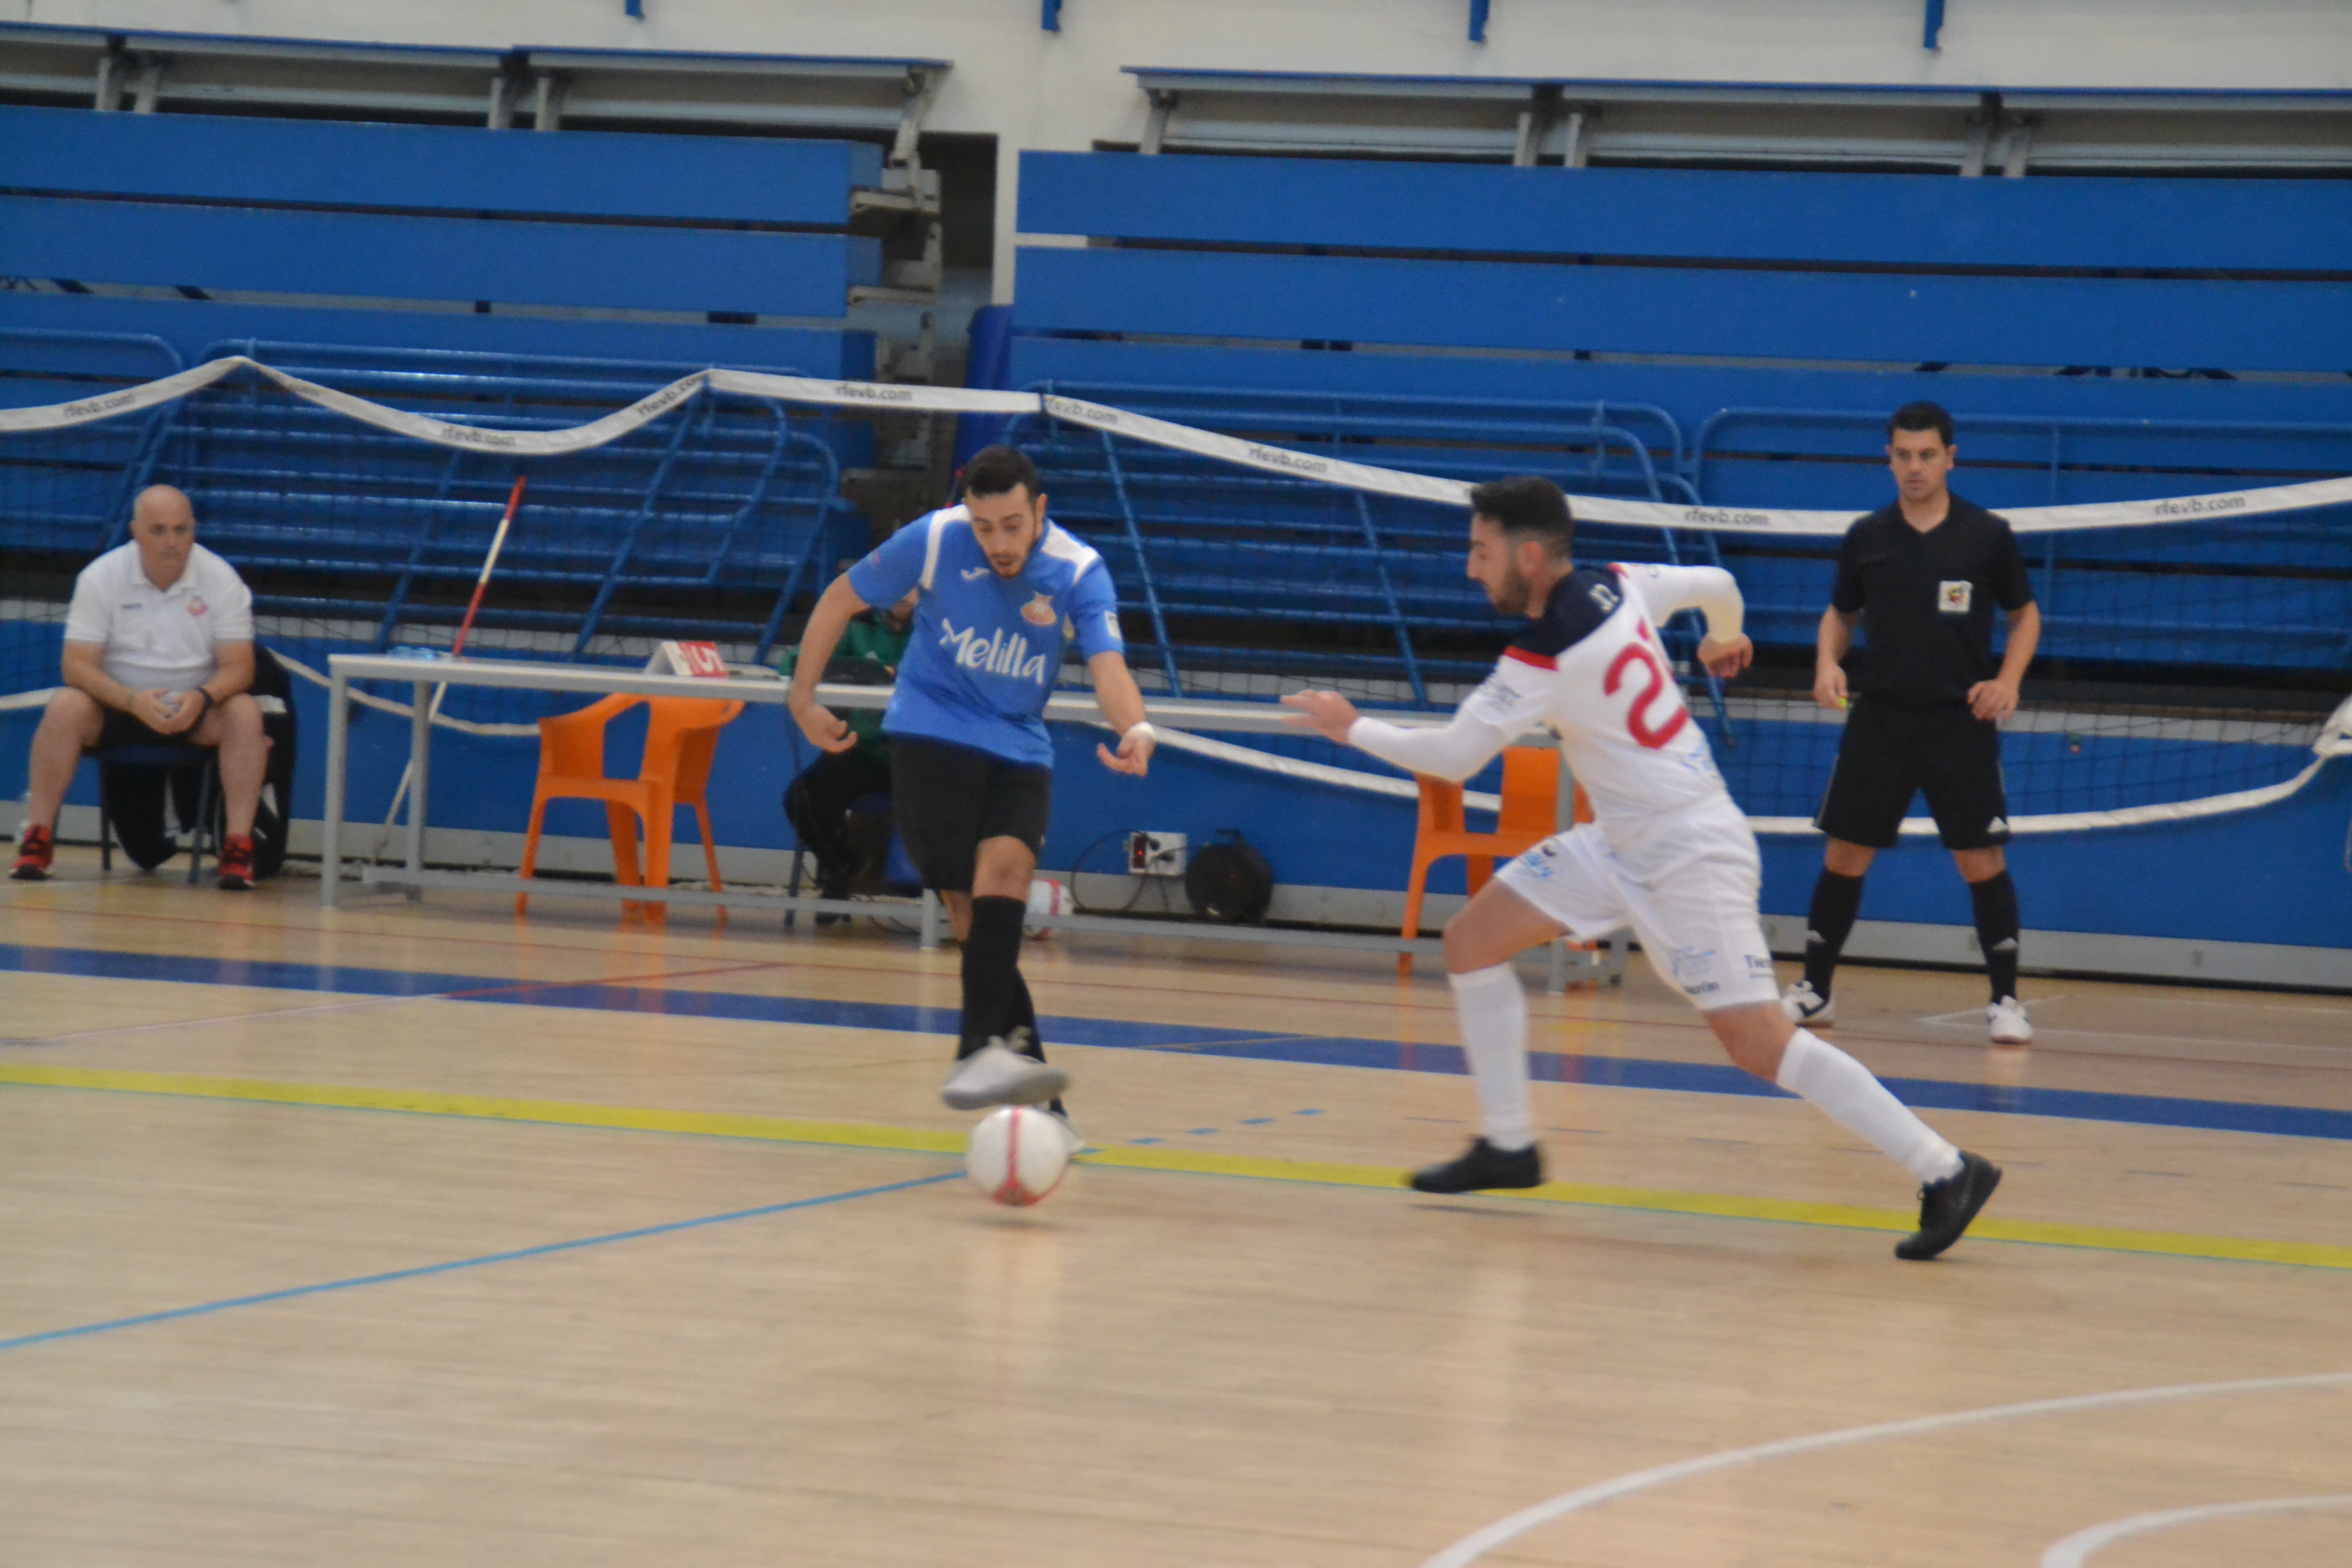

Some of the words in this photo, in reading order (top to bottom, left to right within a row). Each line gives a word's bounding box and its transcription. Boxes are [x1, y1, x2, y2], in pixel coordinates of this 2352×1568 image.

[835, 382, 912, 401] rfevb.com
[1250, 444, 1326, 473] rfevb.com
[2154, 497, 2245, 514] rfevb.com
[1684, 506, 1769, 525] rfevb.com
[939, 617, 1047, 685] Melilla
